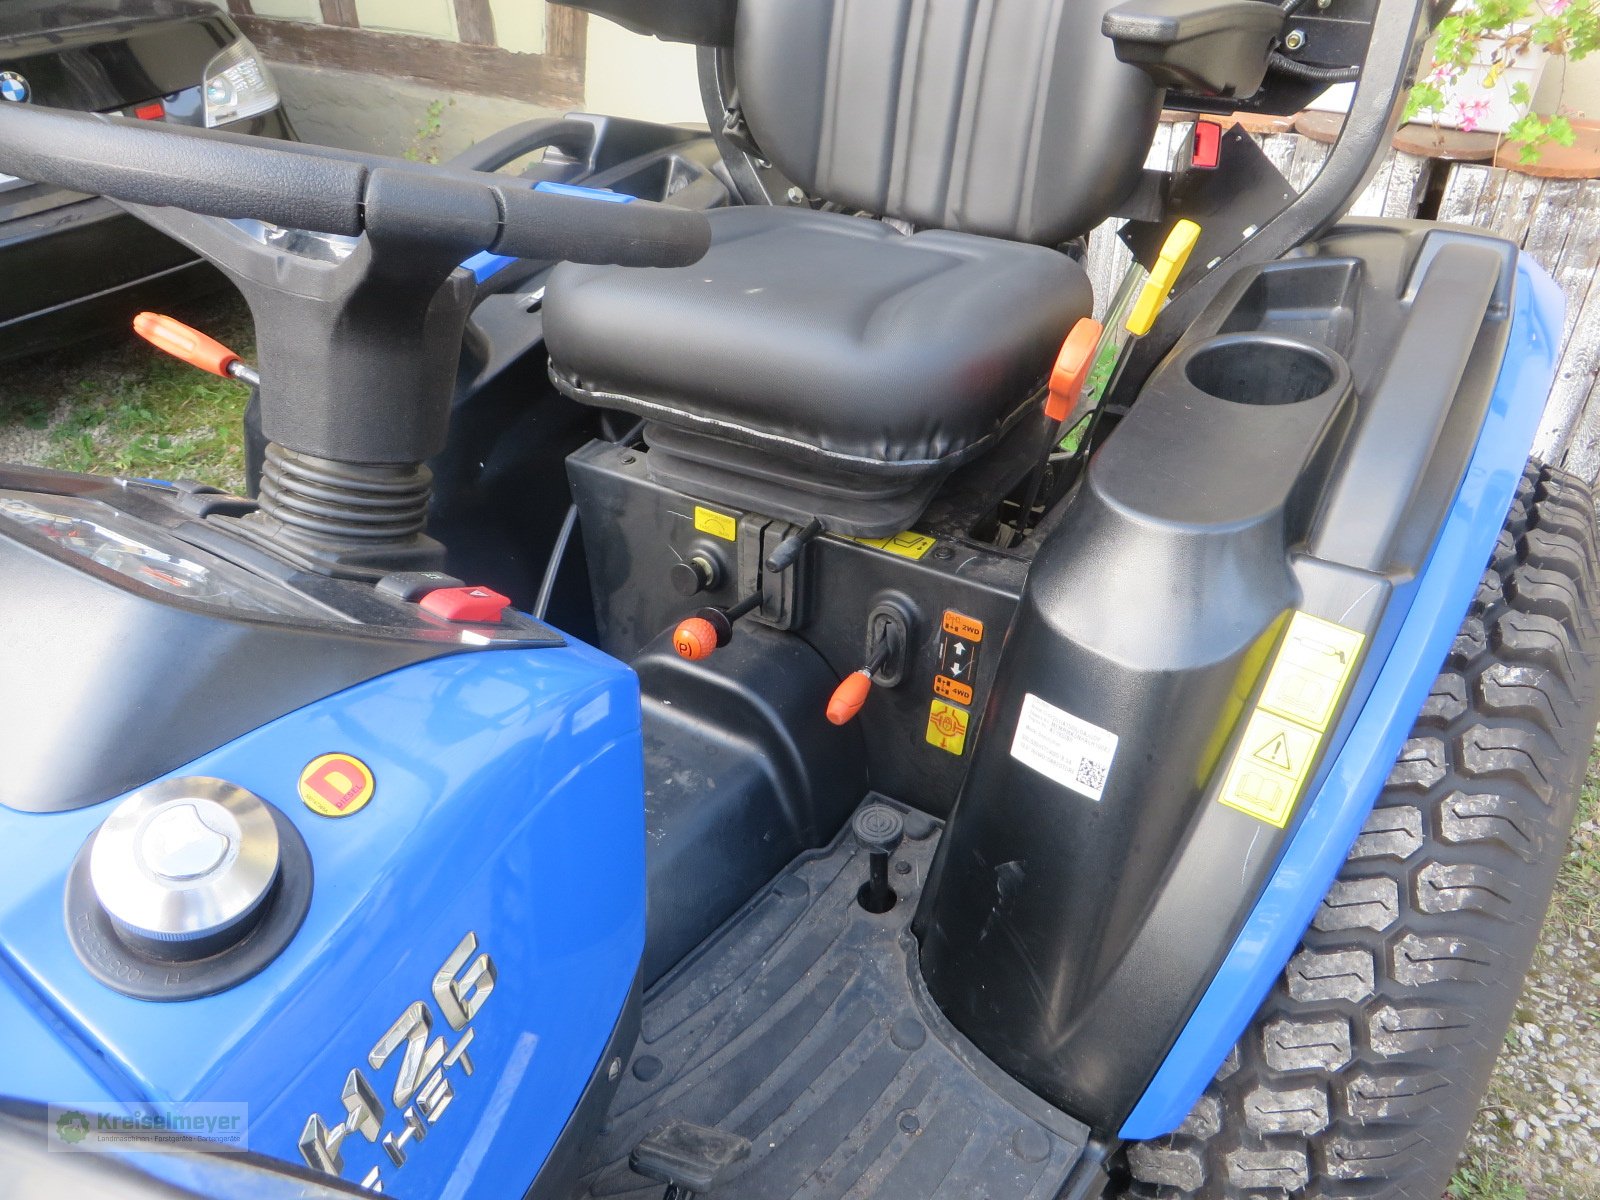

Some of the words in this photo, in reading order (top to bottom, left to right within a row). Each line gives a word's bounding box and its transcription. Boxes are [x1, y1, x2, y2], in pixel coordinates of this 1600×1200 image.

[962, 624, 980, 635] 2WD
[952, 688, 970, 699] 4WD
[304, 758, 367, 812] D
[335, 784, 363, 809] DIESEL
[382, 1026, 475, 1169] HST
